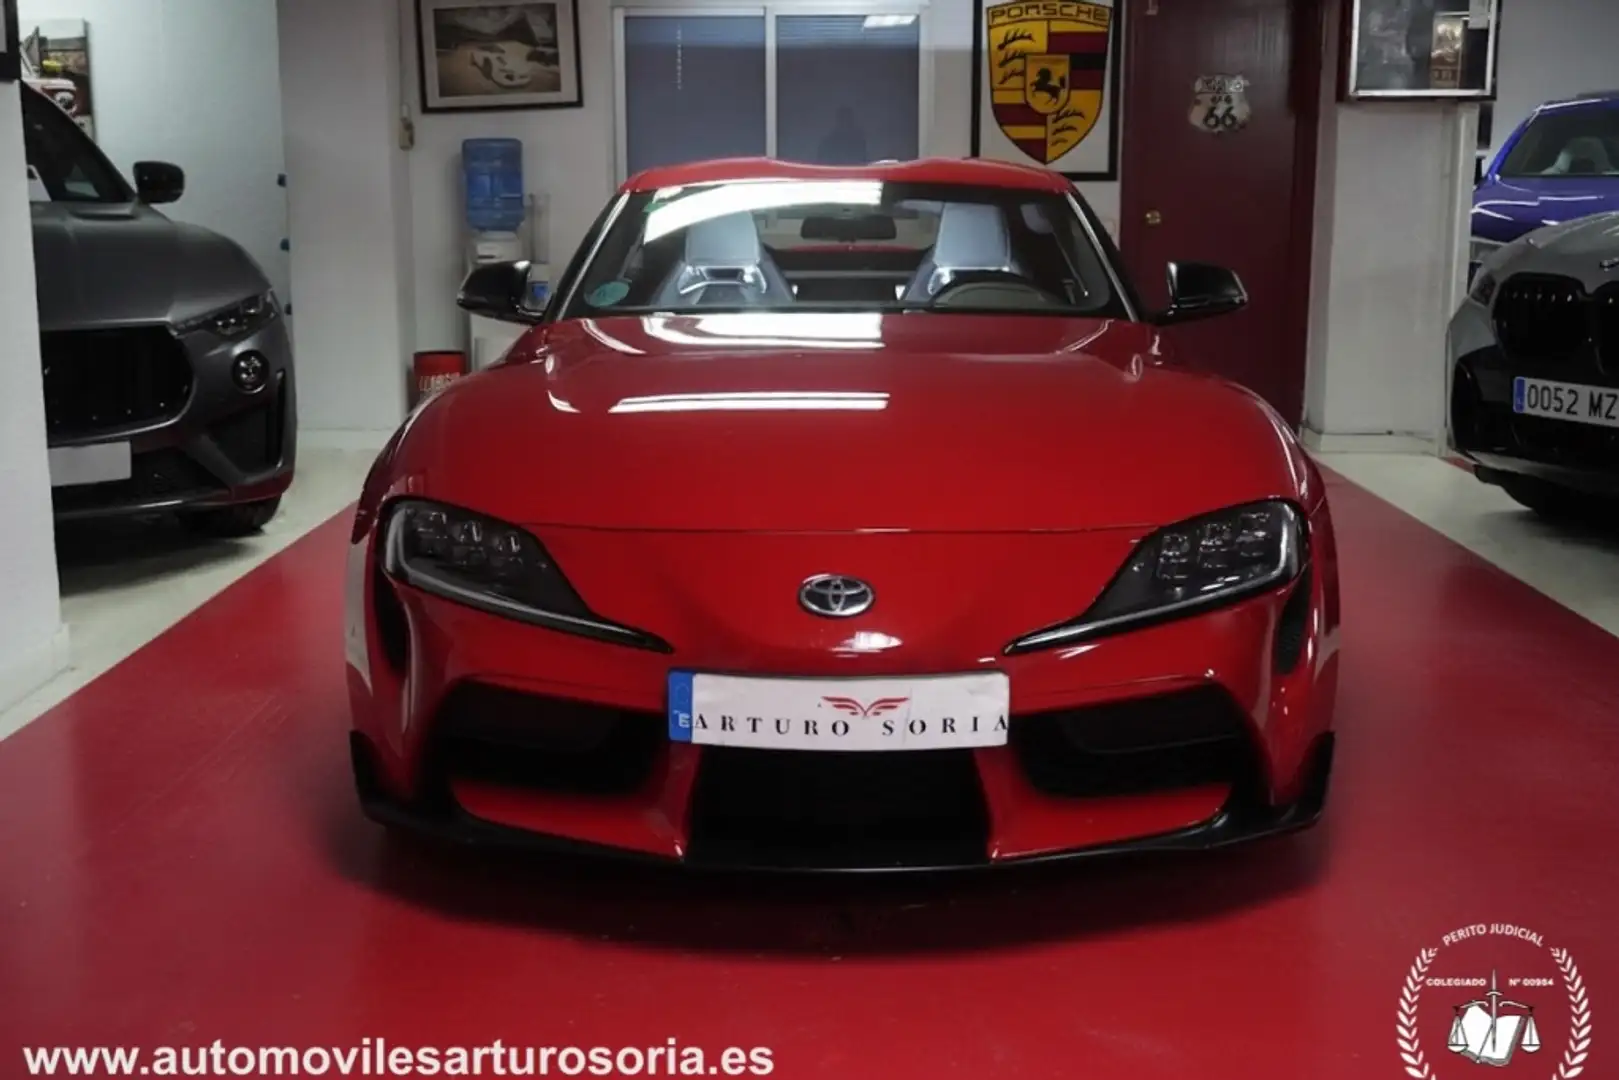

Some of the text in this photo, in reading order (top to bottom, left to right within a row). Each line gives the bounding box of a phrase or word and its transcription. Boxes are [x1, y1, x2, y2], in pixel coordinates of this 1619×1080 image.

[991, 3, 1107, 20] PORSCHE
[1203, 106, 1236, 128] 66
[1527, 384, 1618, 420] 0052 MZ
[694, 713, 1009, 736] ARTURO SORIA
